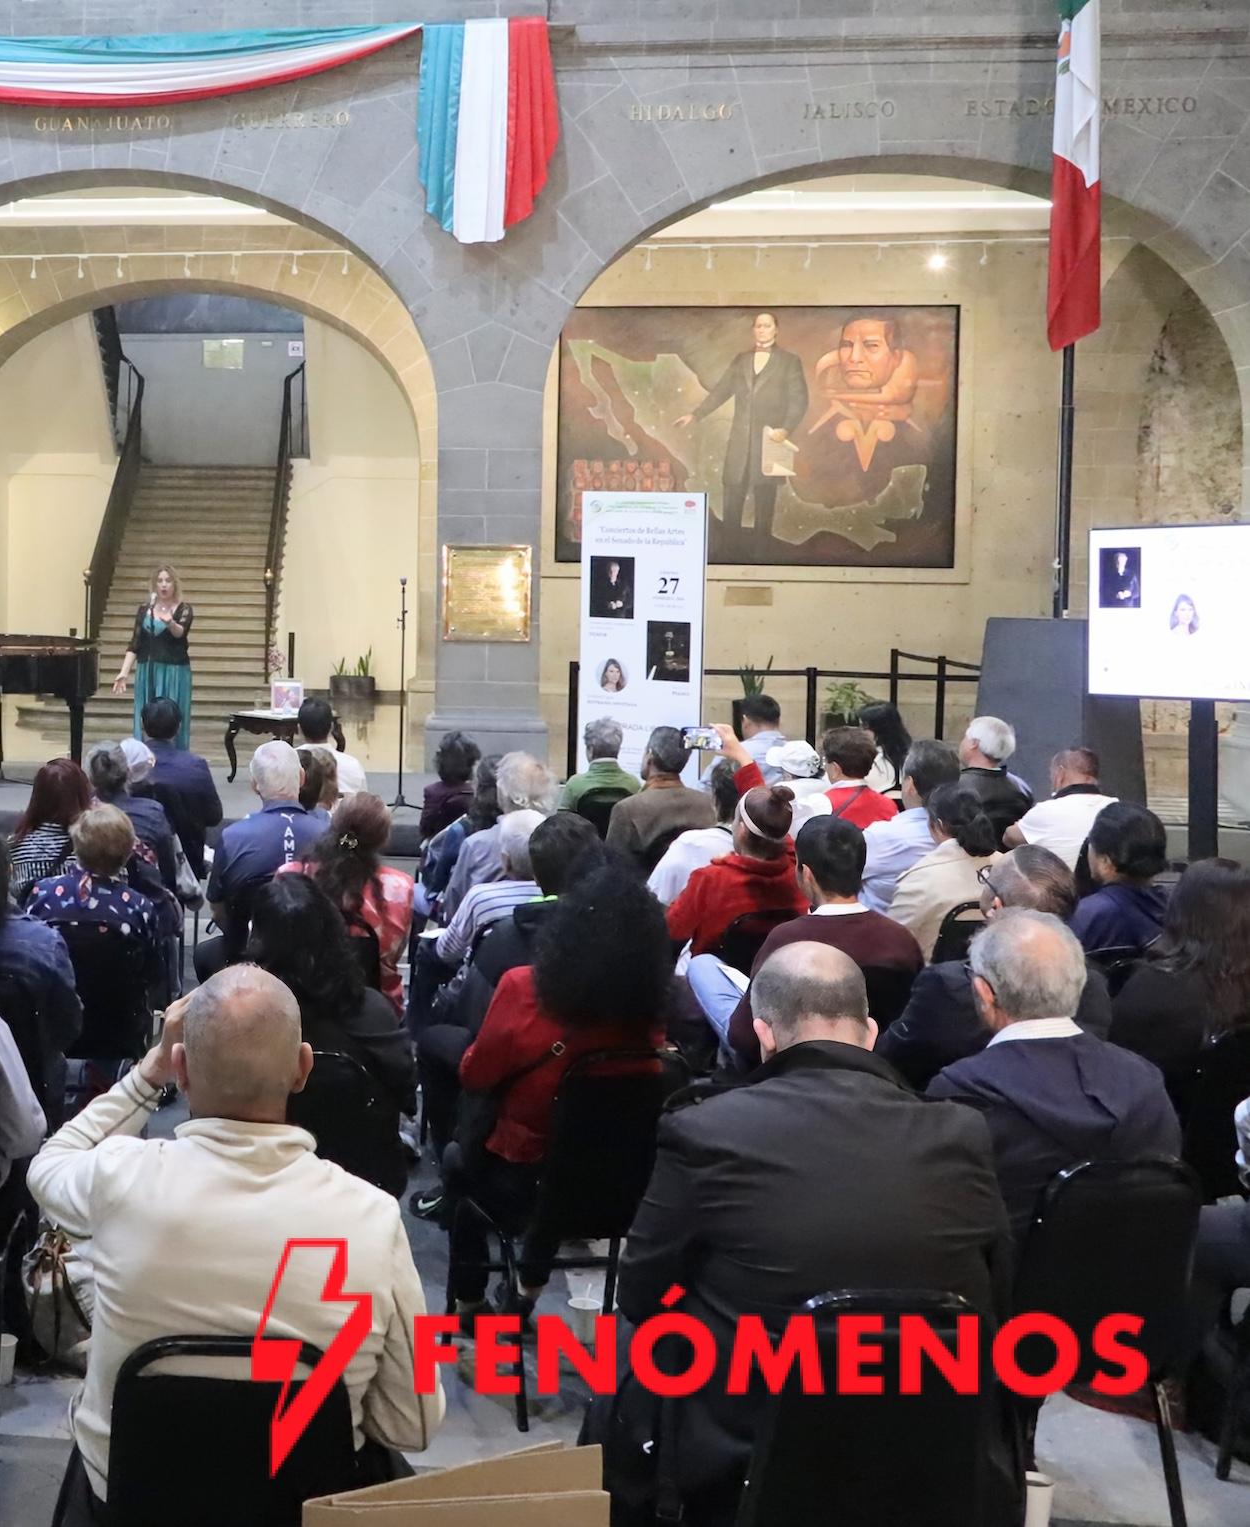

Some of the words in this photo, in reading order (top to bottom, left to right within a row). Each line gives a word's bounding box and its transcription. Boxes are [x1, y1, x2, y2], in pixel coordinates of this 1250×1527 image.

[629, 103, 734, 122] HIDALGO
[802, 100, 896, 120] JALISCO
[1102, 96, 1198, 116] MEXICO
[657, 577, 680, 594] 27
